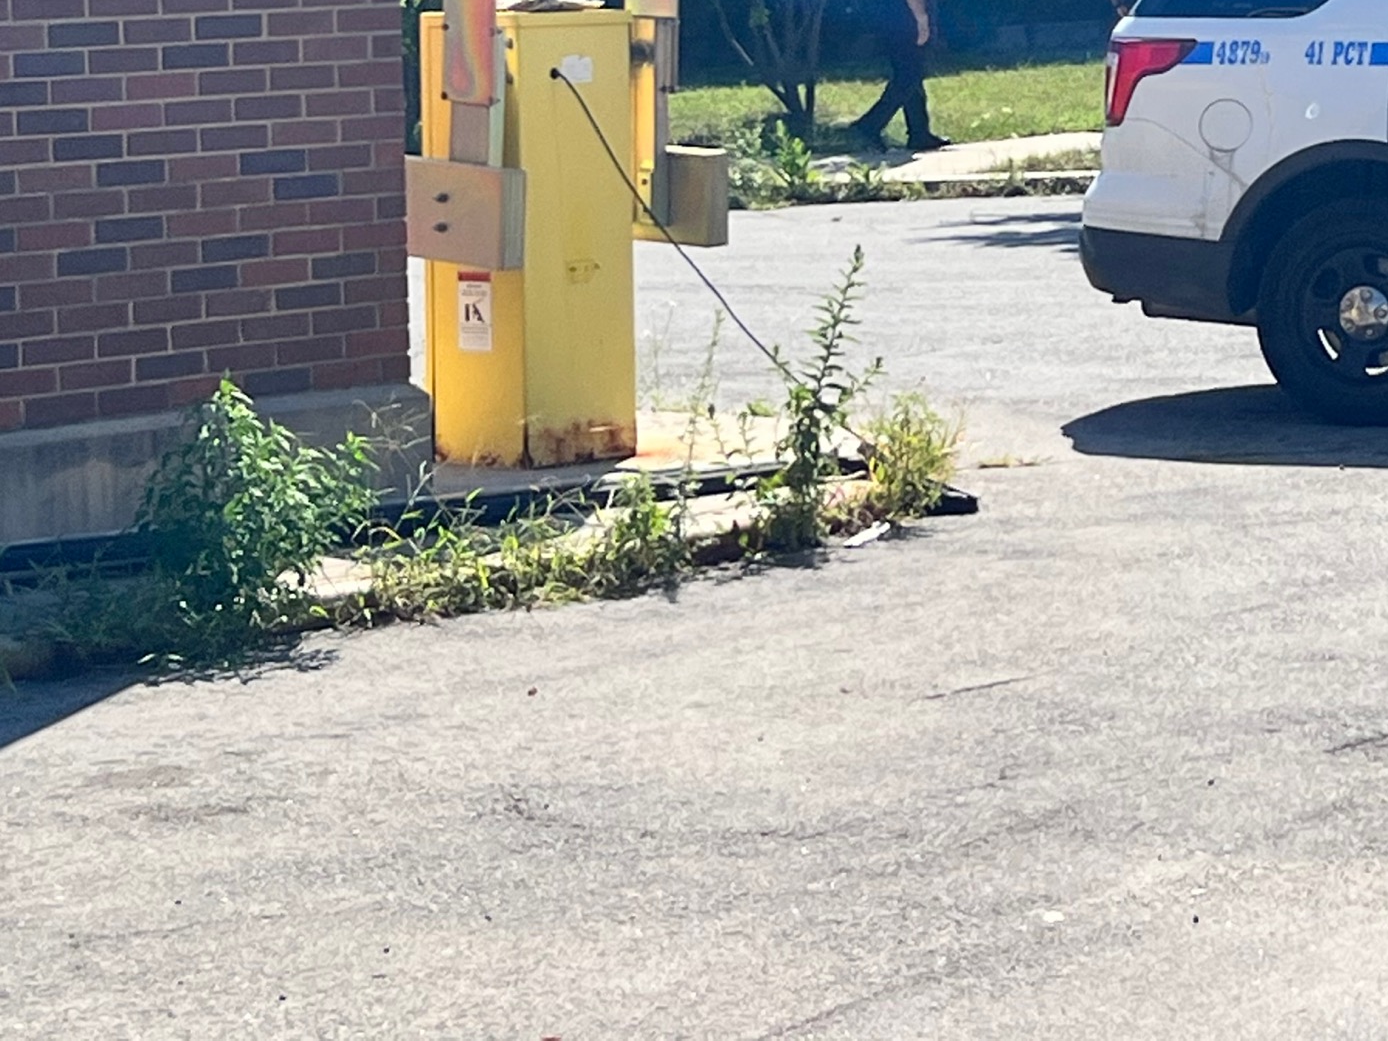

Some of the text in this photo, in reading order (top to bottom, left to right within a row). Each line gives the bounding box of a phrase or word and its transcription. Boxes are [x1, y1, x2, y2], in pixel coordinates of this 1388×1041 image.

[1216, 40, 1262, 65] 4879
[1304, 40, 1368, 66] 41 PCT
